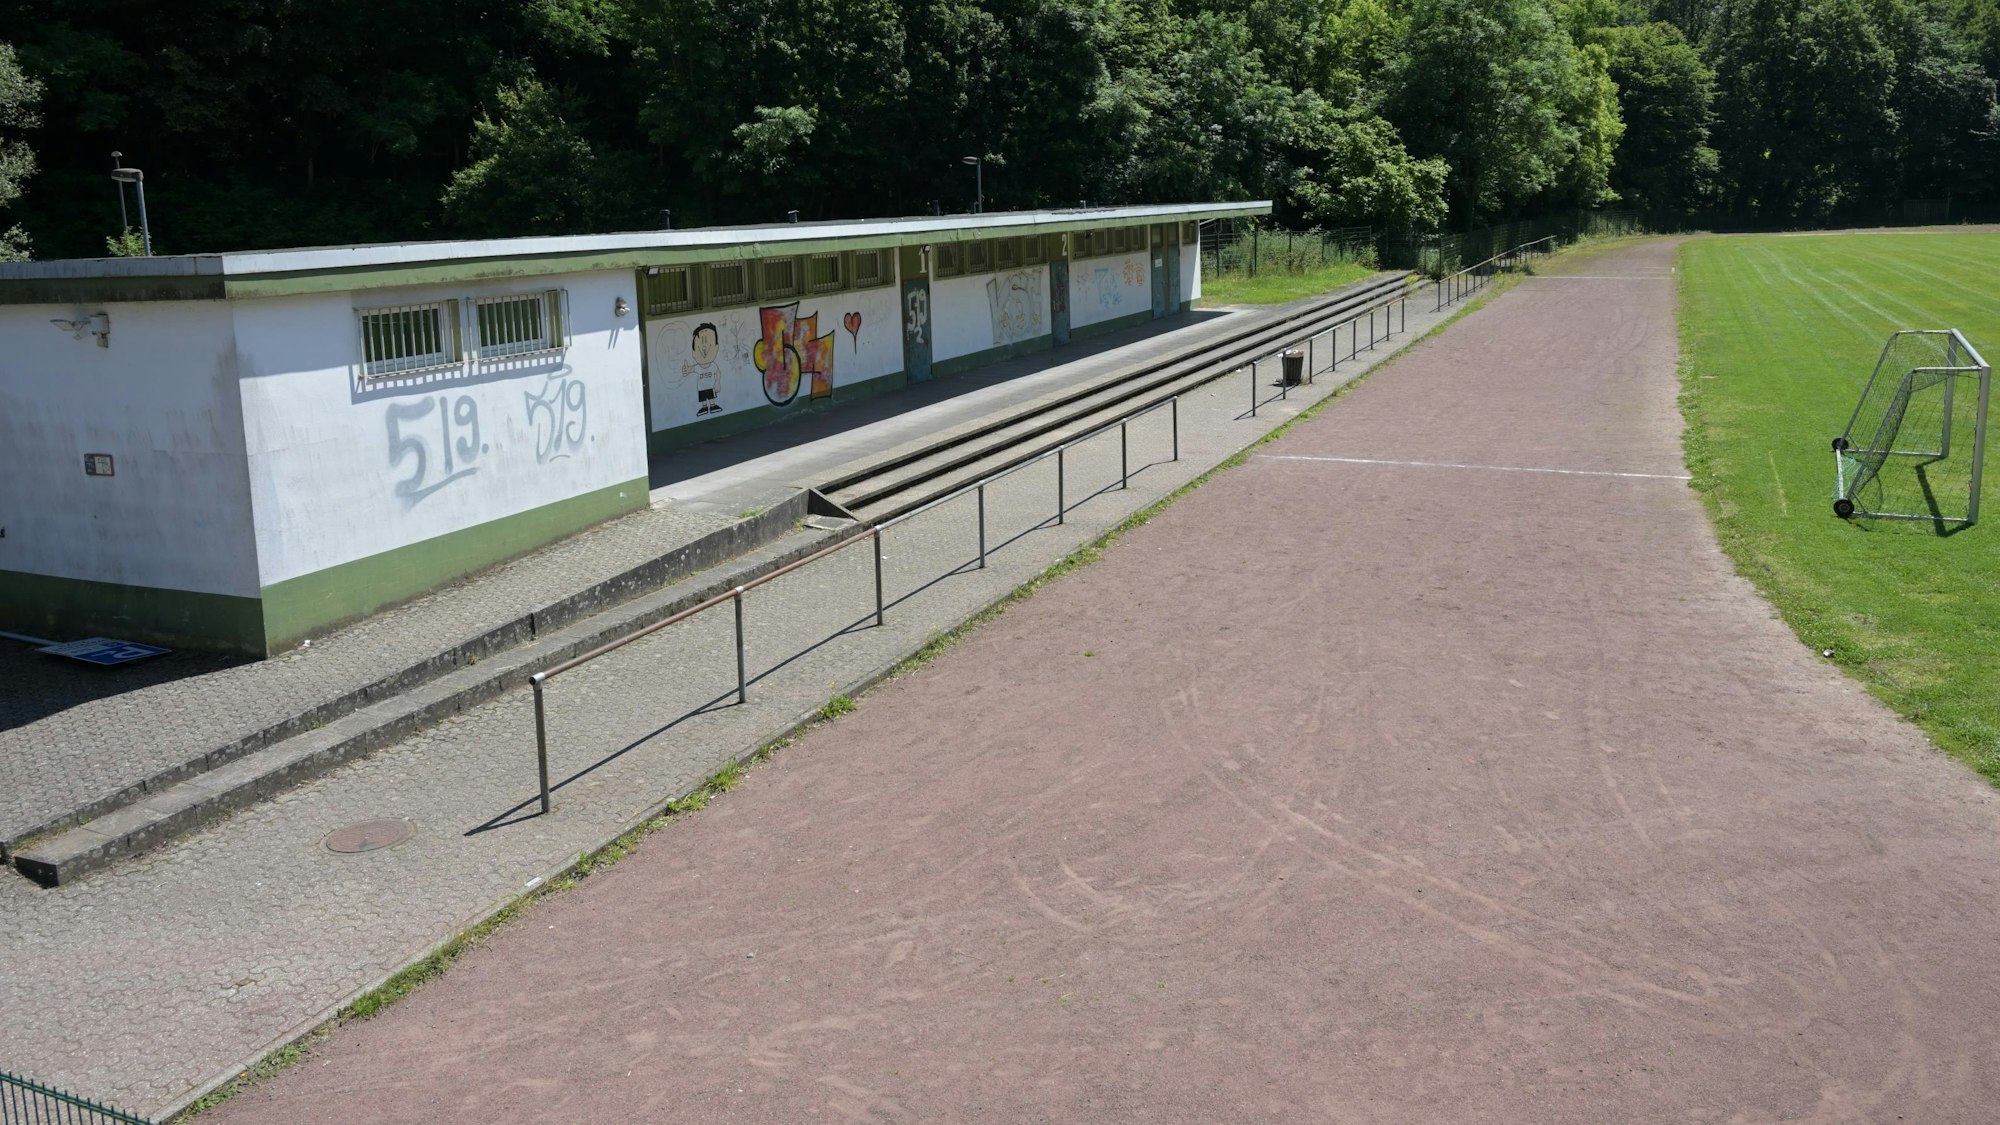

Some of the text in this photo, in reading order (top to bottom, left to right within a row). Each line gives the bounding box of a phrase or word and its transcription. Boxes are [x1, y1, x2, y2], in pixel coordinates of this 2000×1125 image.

[1062, 234, 1068, 256] 2
[919, 246, 927, 273] 1
[385, 395, 489, 505] 519.
[113, 646, 154, 659] P
